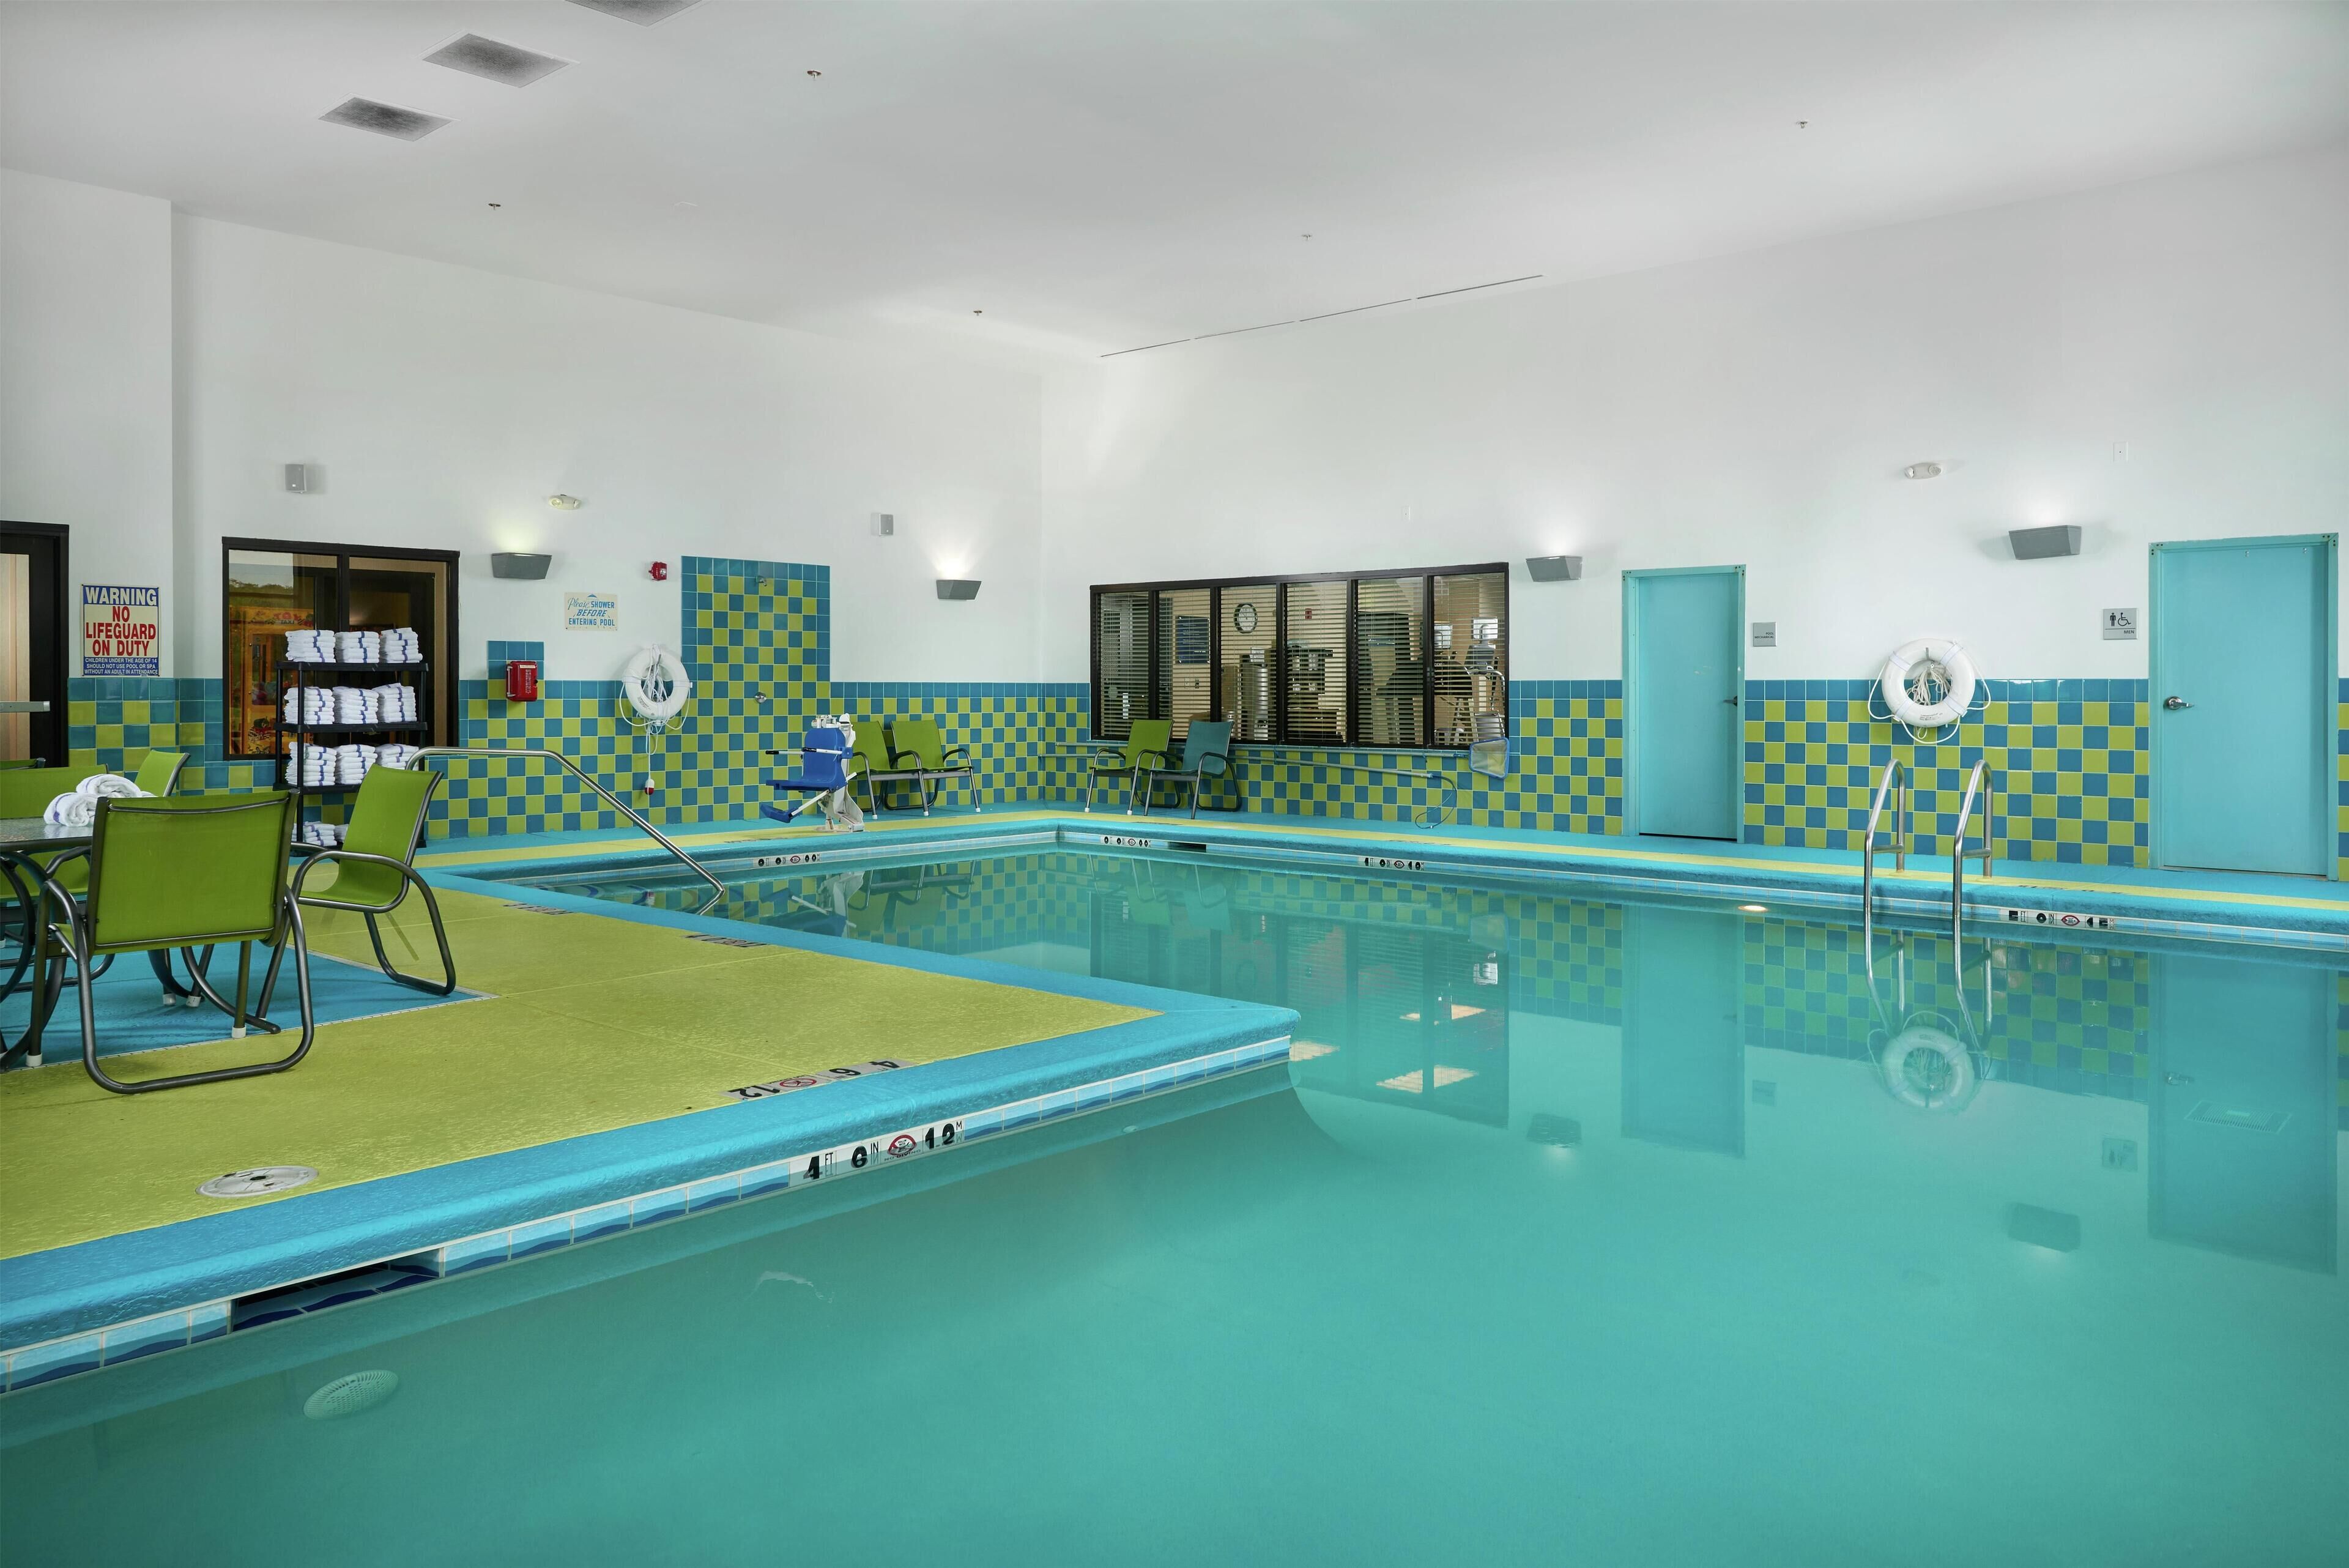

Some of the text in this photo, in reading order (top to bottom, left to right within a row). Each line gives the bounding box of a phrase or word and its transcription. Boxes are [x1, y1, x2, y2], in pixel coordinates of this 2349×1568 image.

[85, 587, 157, 606] WARNING
[568, 597, 590, 611] Please
[113, 606, 130, 622] NO
[86, 622, 156, 640] LIFEGUARD
[92, 639, 150, 656] ON DUTY
[869, 1060, 900, 1069] 4
[803, 1155, 822, 1180] 4
[825, 1152, 833, 1167] FT
[851, 1145, 868, 1169] 6
[870, 1141, 879, 1155] IN
[956, 1120, 962, 1131] M
[897, 1149, 921, 1158] DIVING
